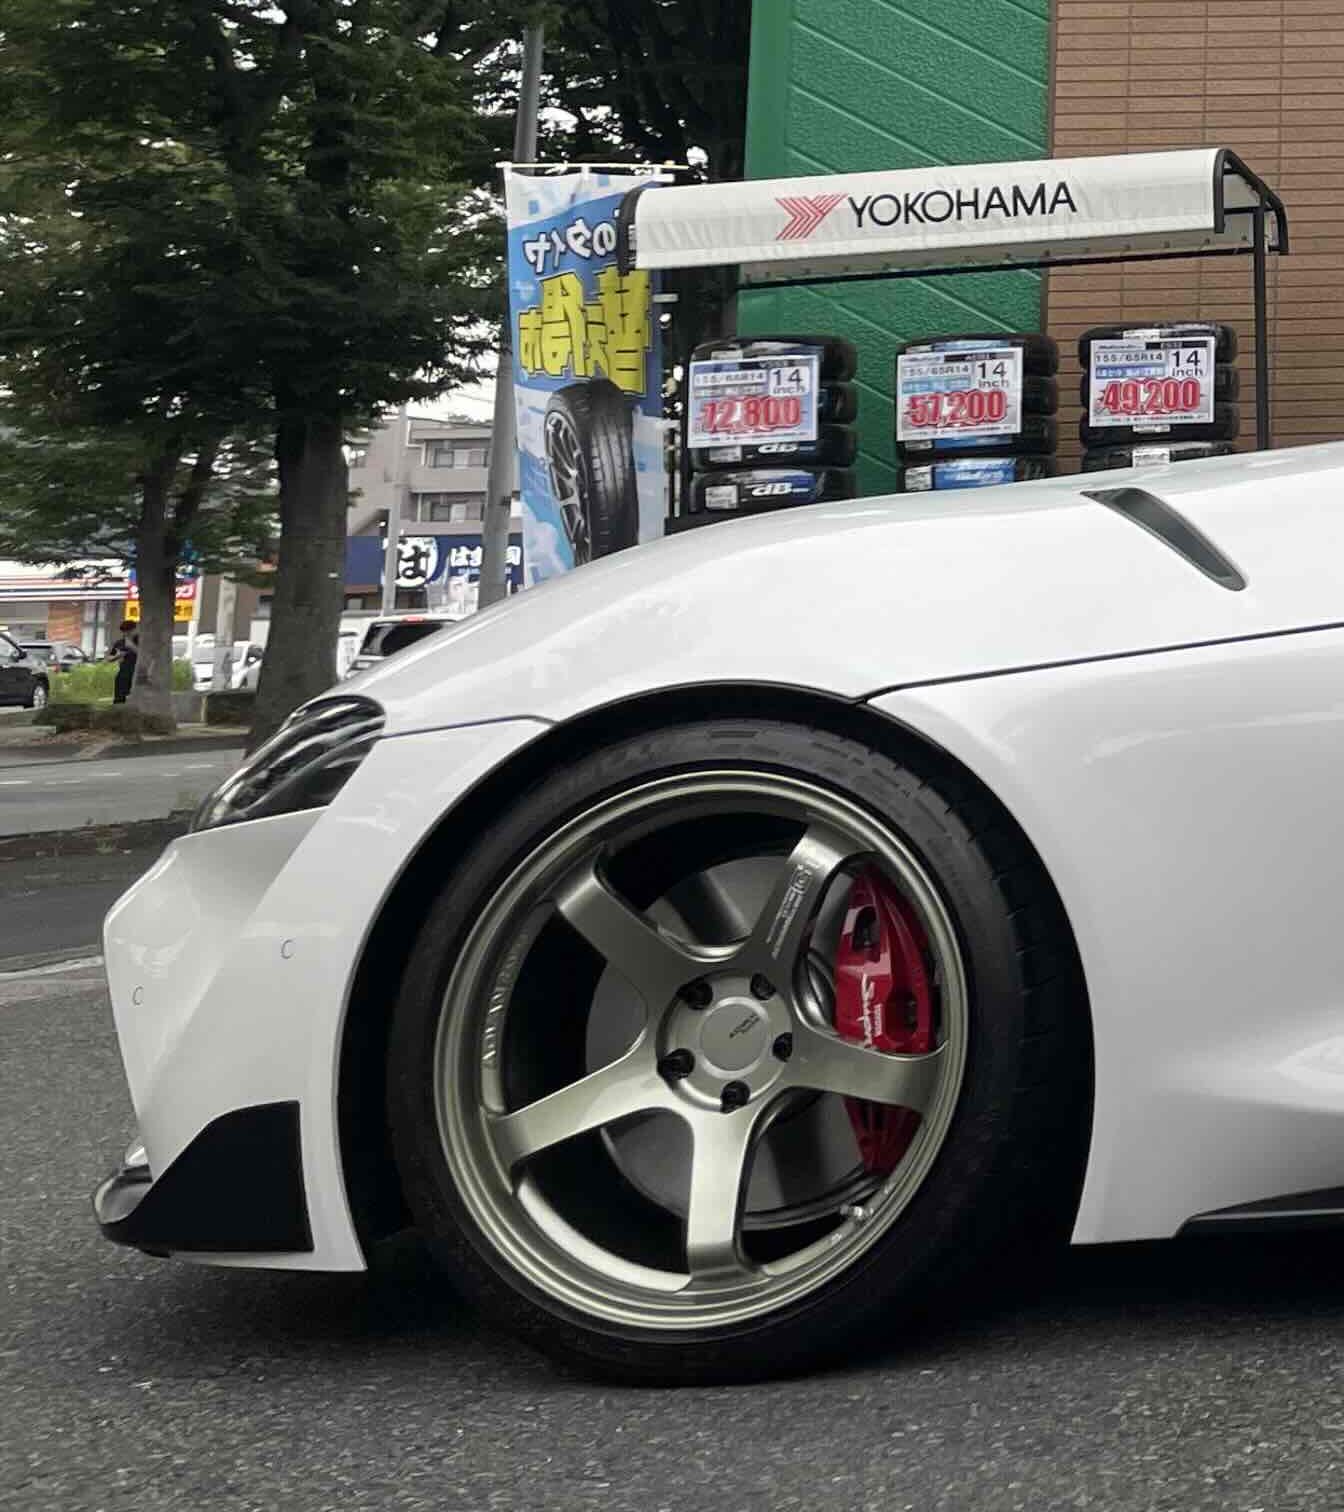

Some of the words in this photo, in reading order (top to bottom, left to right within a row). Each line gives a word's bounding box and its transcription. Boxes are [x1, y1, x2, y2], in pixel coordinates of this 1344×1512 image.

[847, 179, 1078, 229] YOKOHAMA
[1172, 350, 1201, 367] 14
[771, 368, 804, 387] 14
[977, 361, 1008, 379] 14
[1172, 367, 1204, 377] inch
[1103, 379, 1201, 413] 49,200
